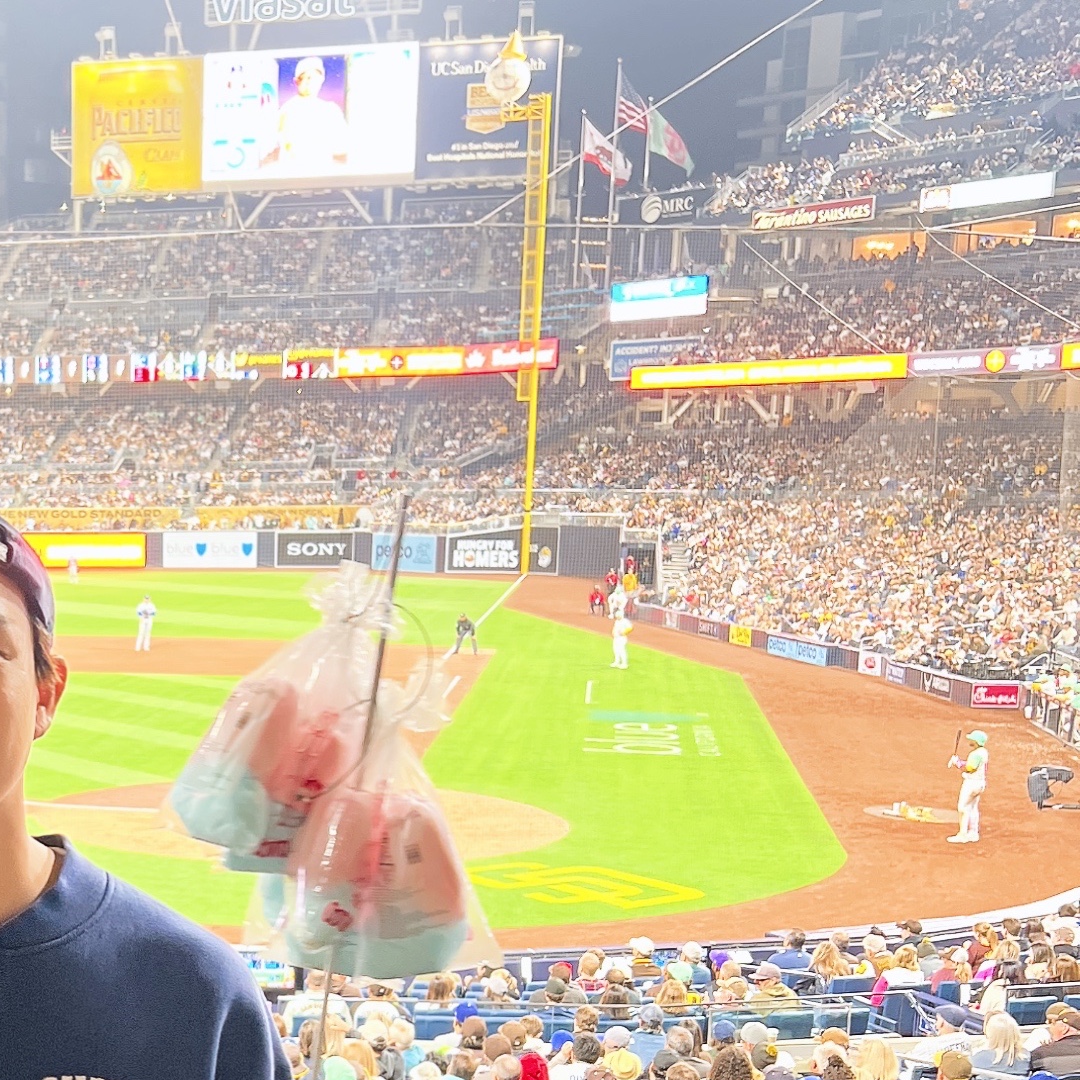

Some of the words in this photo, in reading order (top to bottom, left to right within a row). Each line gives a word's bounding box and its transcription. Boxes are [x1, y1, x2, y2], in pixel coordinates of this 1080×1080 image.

[662, 196, 694, 213] MRC
[754, 207, 818, 229] Tarantino
[818, 204, 871, 223] SAUSAGES
[15, 510, 50, 519] NEW
[51, 510, 88, 519] GOLD
[90, 508, 162, 519] STANDARD
[286, 542, 347, 556] SONY
[376, 543, 413, 560] peco
[456, 540, 495, 551] HUNGRY
[495, 540, 515, 550] FOR
[452, 550, 520, 568] HOMERS
